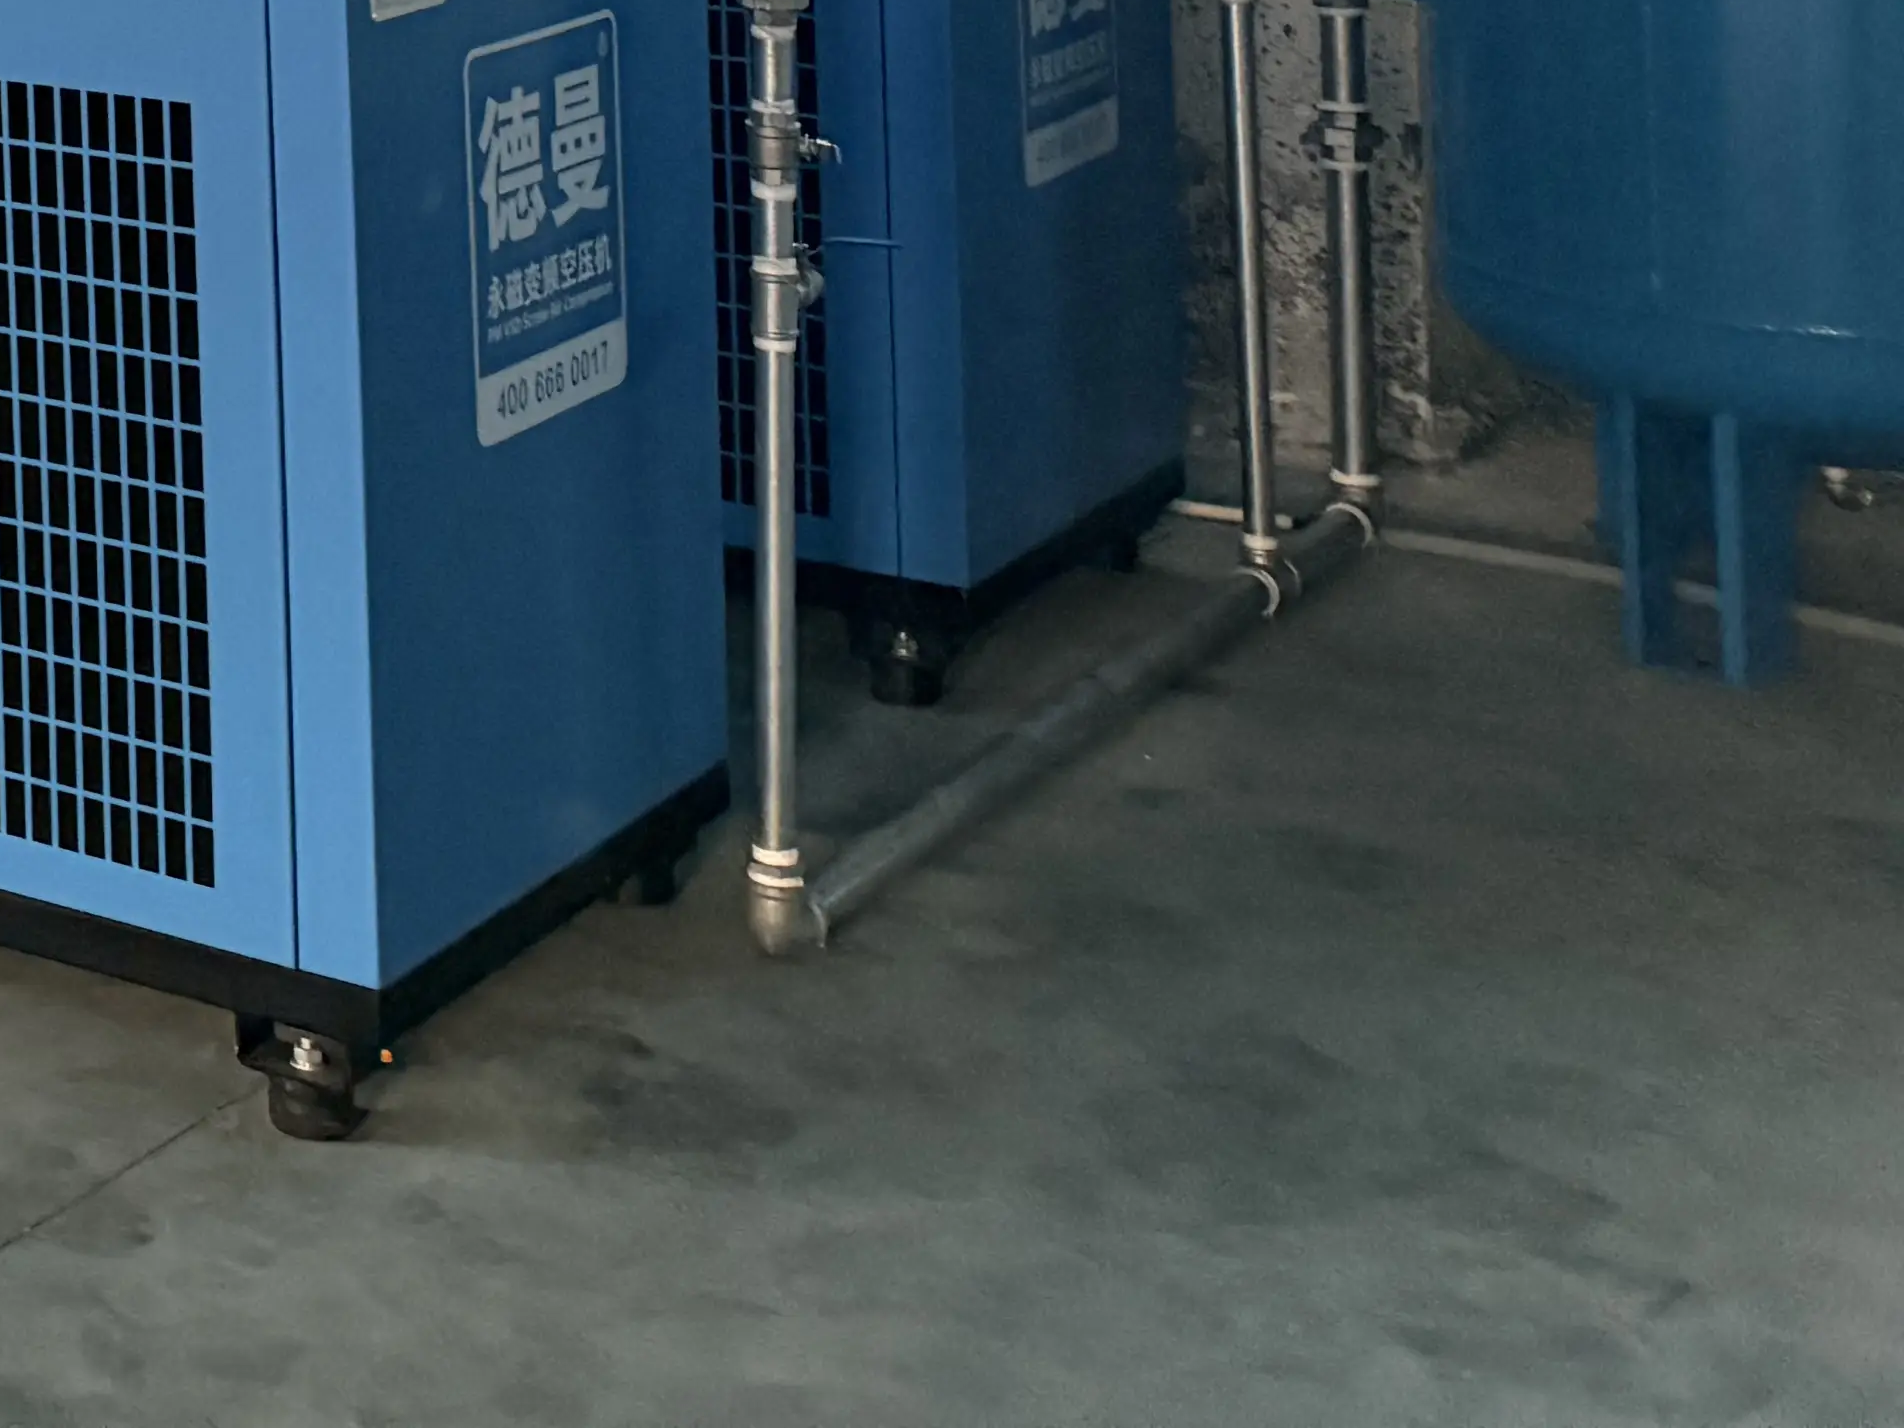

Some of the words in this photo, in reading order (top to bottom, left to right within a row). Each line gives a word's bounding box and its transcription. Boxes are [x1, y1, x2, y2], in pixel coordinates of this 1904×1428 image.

[478, 63, 610, 252] 德曼
[497, 376, 529, 419] 400
[535, 361, 566, 404] 666
[570, 340, 609, 387] 0017
